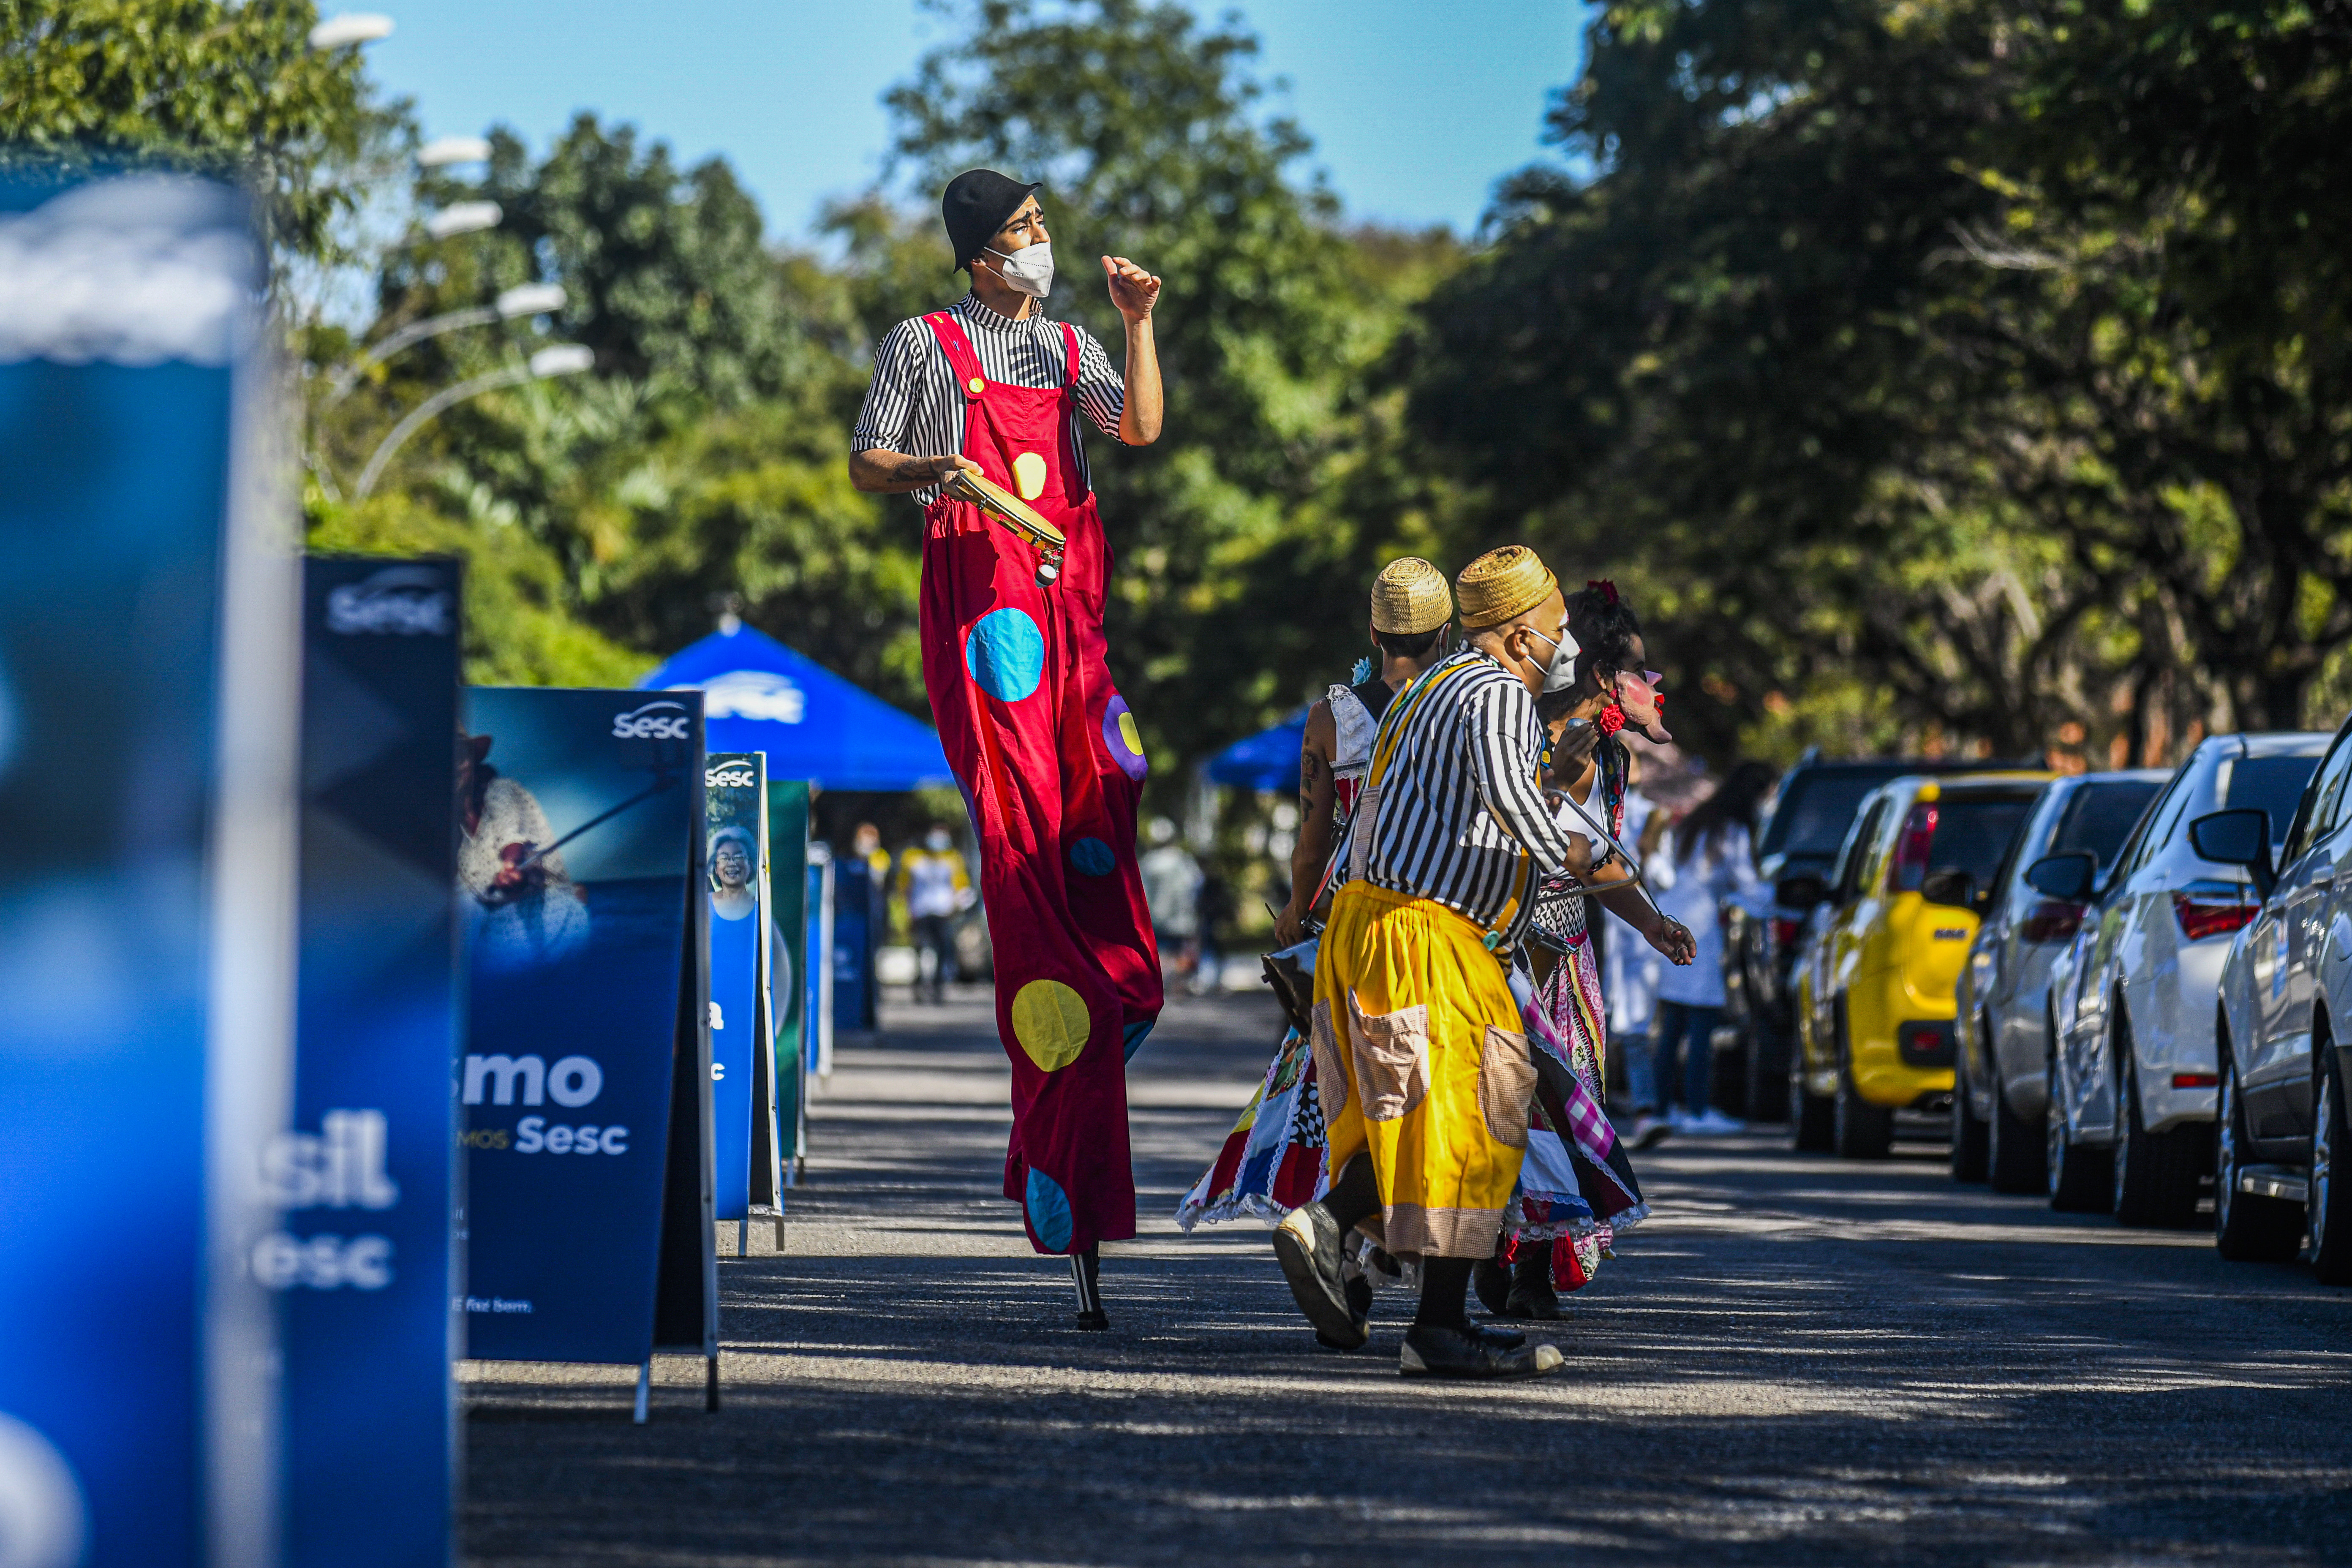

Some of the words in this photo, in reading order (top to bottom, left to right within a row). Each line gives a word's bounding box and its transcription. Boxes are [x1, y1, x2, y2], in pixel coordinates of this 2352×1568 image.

[612, 700, 689, 739] Sesc
[705, 760, 754, 787] Sesc
[514, 1115, 629, 1155] Sesc
[247, 1233, 395, 1290] esc
